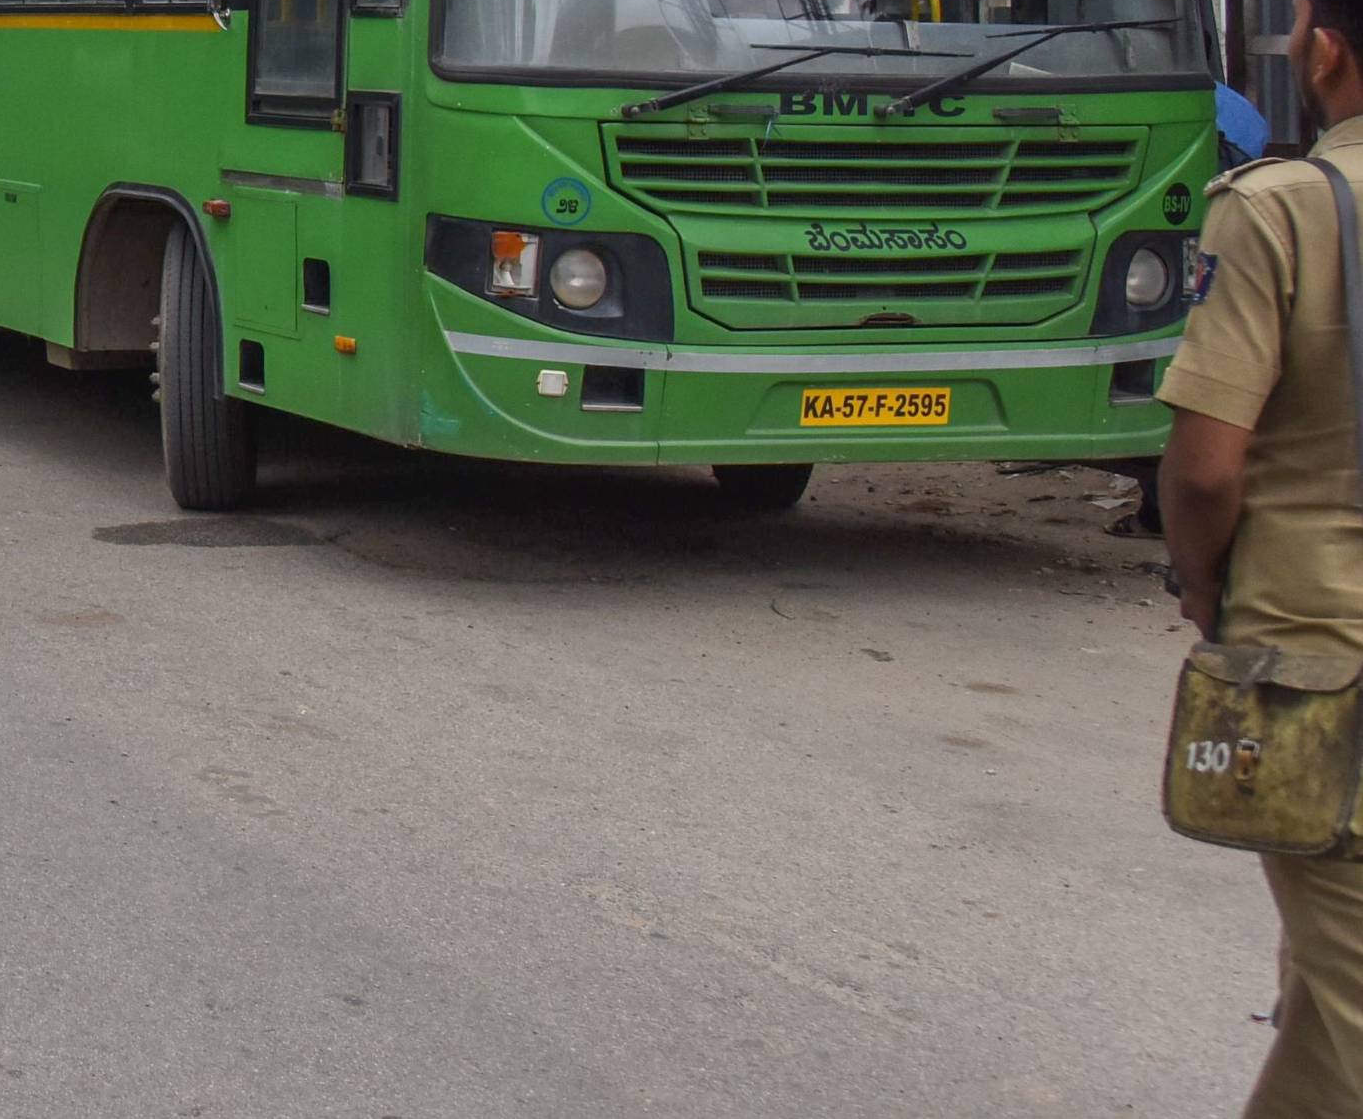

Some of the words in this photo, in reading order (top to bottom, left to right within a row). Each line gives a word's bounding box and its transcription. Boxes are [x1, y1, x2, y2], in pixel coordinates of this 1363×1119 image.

[779, 91, 966, 118] BMC
[1164, 195, 1190, 212] BS-IV
[803, 394, 947, 419] KA-57-F-2595
[1186, 740, 1231, 773] 130
